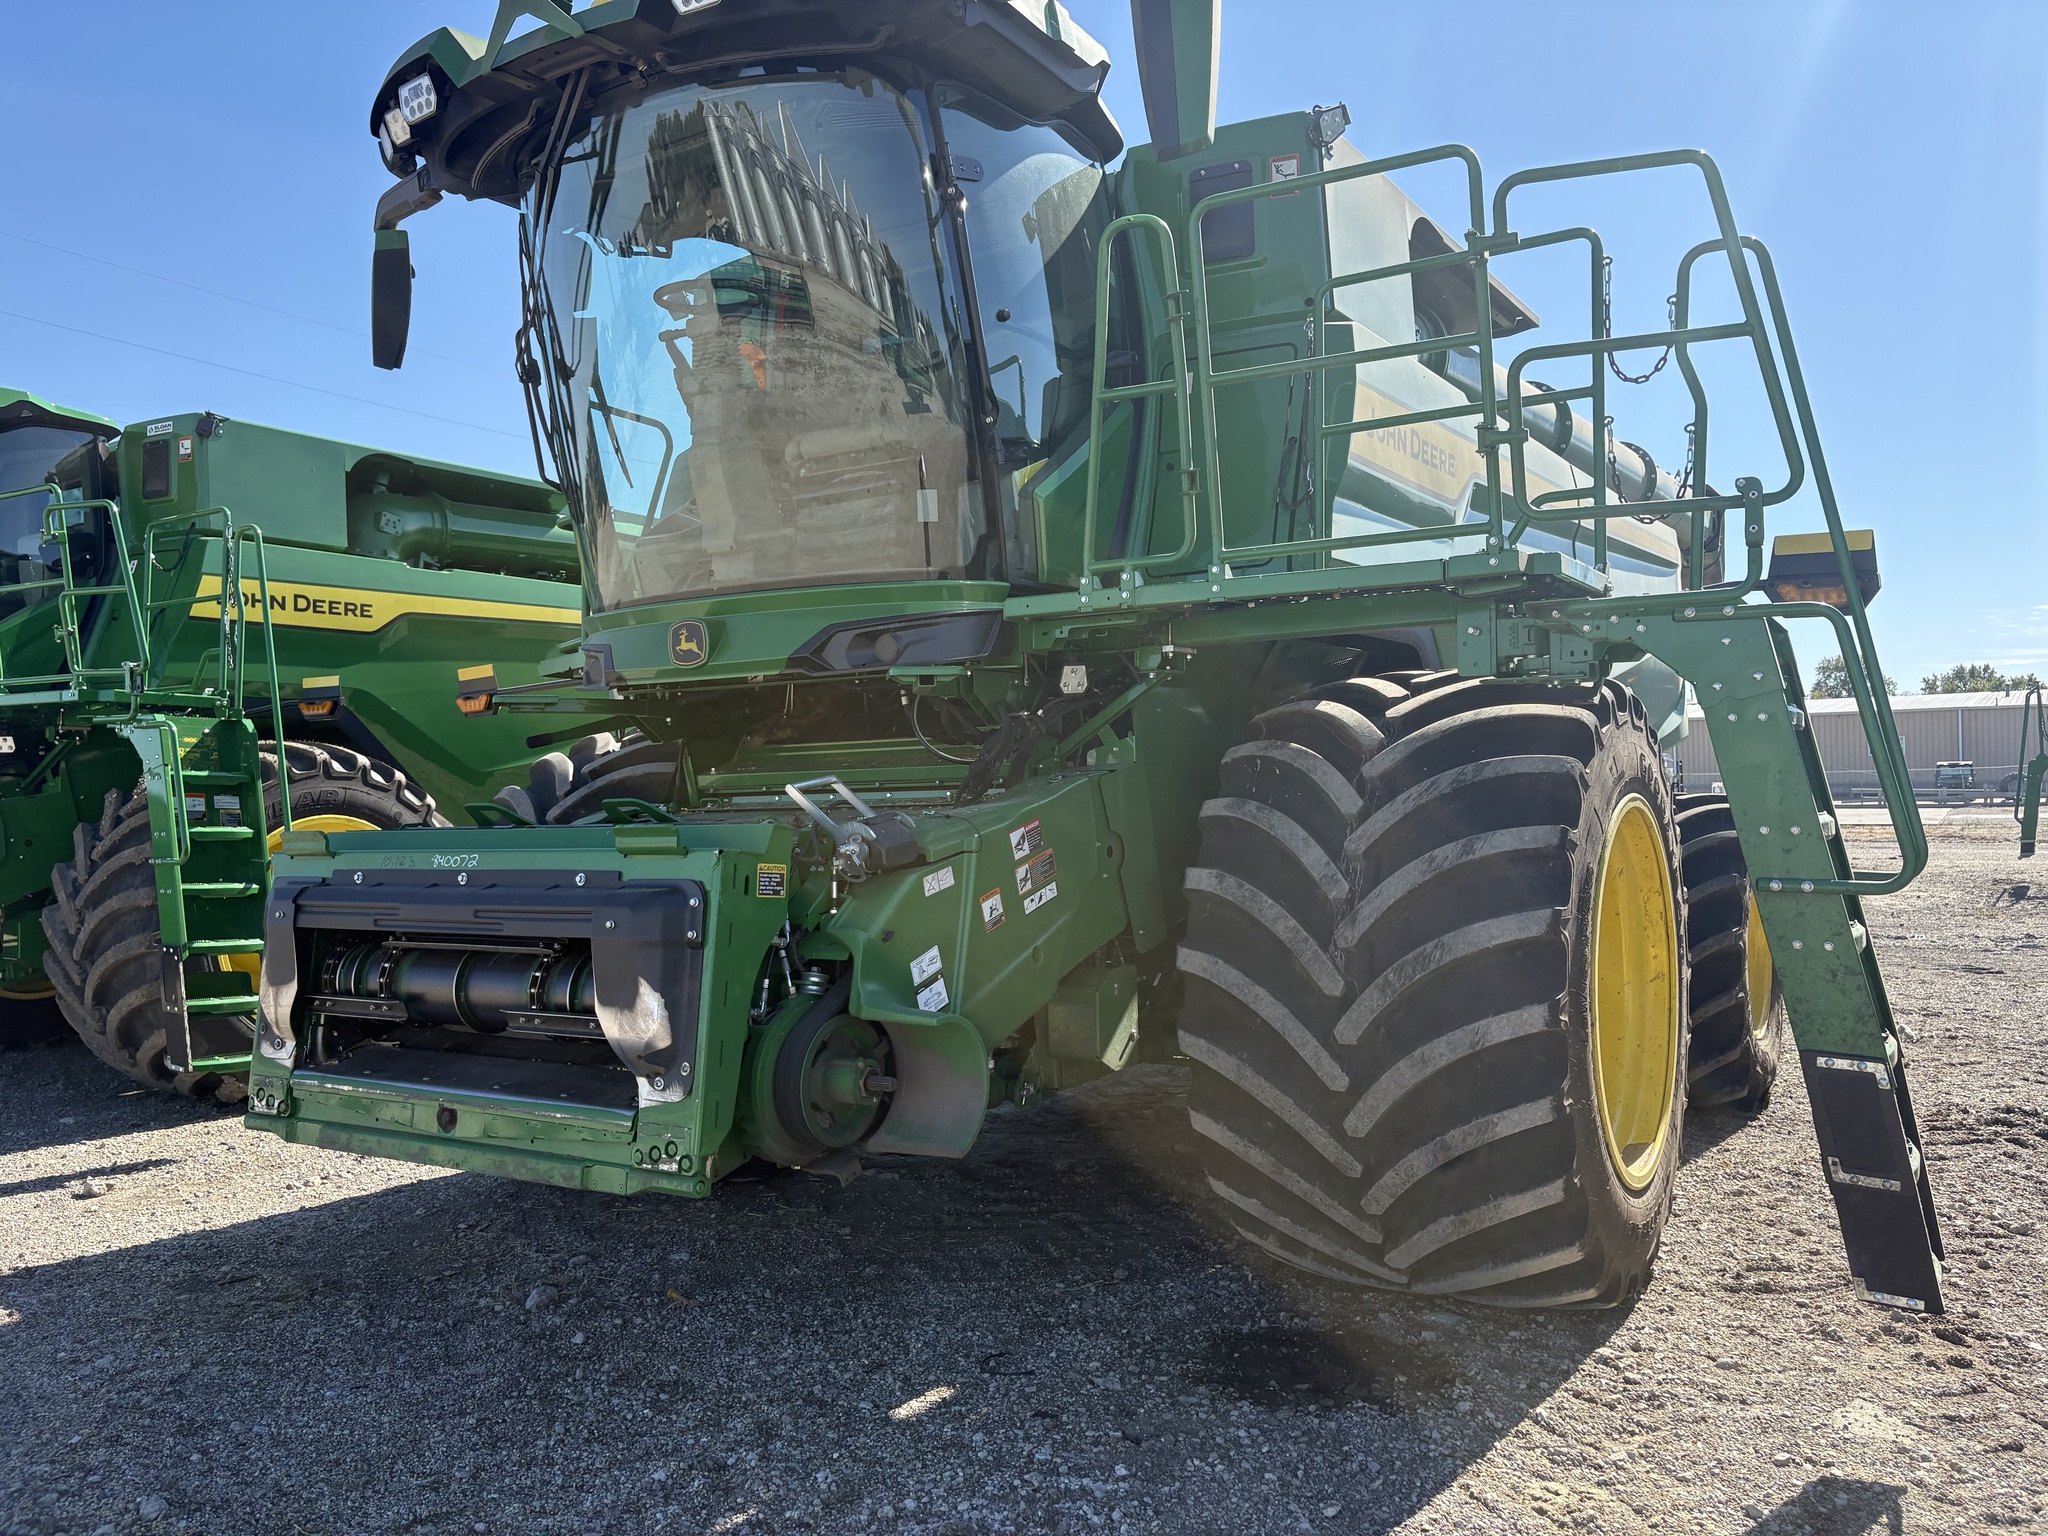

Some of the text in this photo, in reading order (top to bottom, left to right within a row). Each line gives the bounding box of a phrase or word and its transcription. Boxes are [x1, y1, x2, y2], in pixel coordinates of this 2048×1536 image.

[1411, 428, 1456, 478] DEERE
[217, 591, 373, 618] OHN DEERE
[431, 854, 479, 868] 840072
